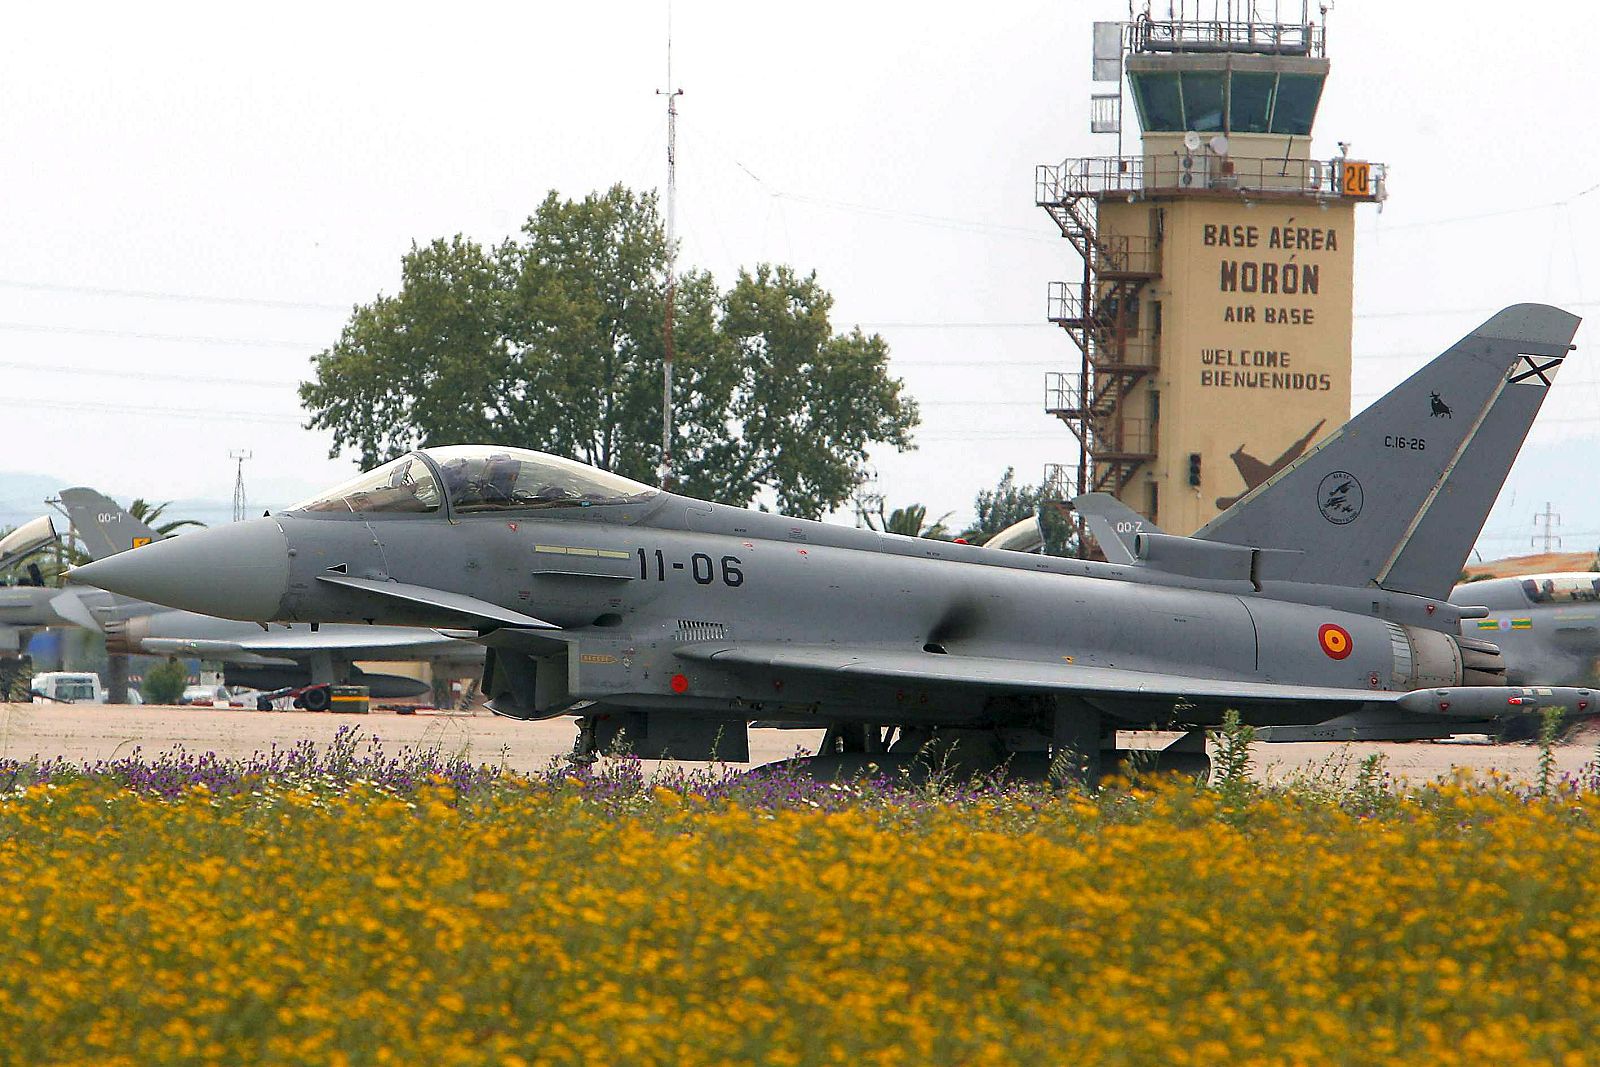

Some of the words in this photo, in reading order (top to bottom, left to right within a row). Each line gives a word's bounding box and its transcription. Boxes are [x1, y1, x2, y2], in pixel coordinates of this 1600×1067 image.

[1346, 165, 1367, 192] 20
[1203, 224, 1258, 247] BASE
[1269, 217, 1337, 251] AÉREA
[1220, 254, 1319, 294] MORÓN
[1224, 306, 1256, 323] AIR
[1265, 307, 1314, 325] BASE
[1201, 349, 1290, 368] WELCOME
[1384, 435, 1426, 450] C.16-26
[637, 547, 744, 587] 11-06
